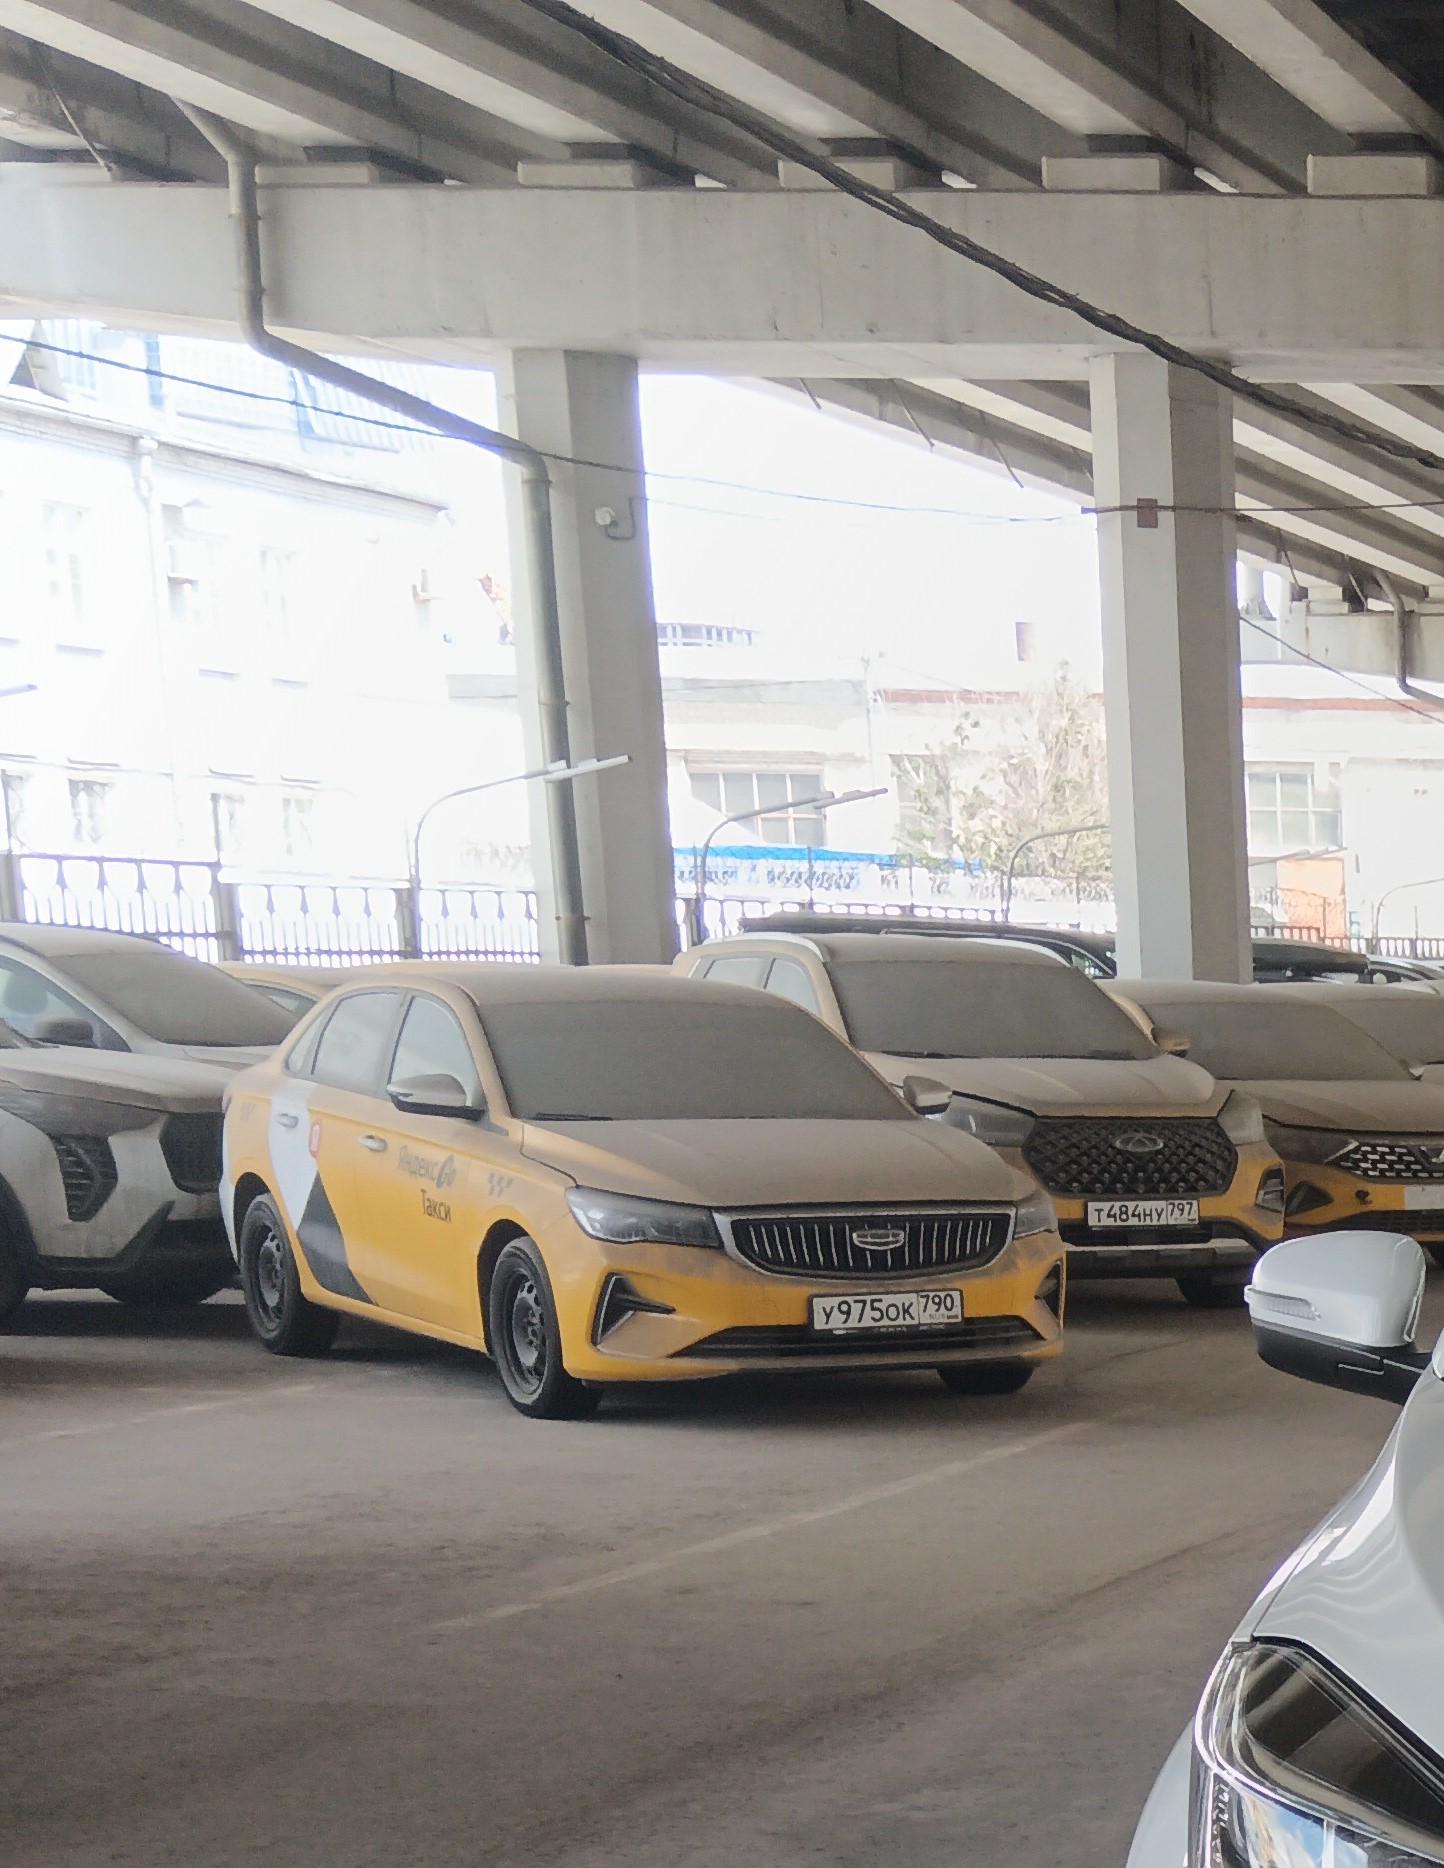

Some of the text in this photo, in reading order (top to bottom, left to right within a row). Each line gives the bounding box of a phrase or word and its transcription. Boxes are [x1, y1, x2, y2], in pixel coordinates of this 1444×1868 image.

[420, 1188, 452, 1224] Такси
[1094, 1202, 1194, 1223] Т484НУ 797
[822, 1293, 955, 1324] У975ОК 790
